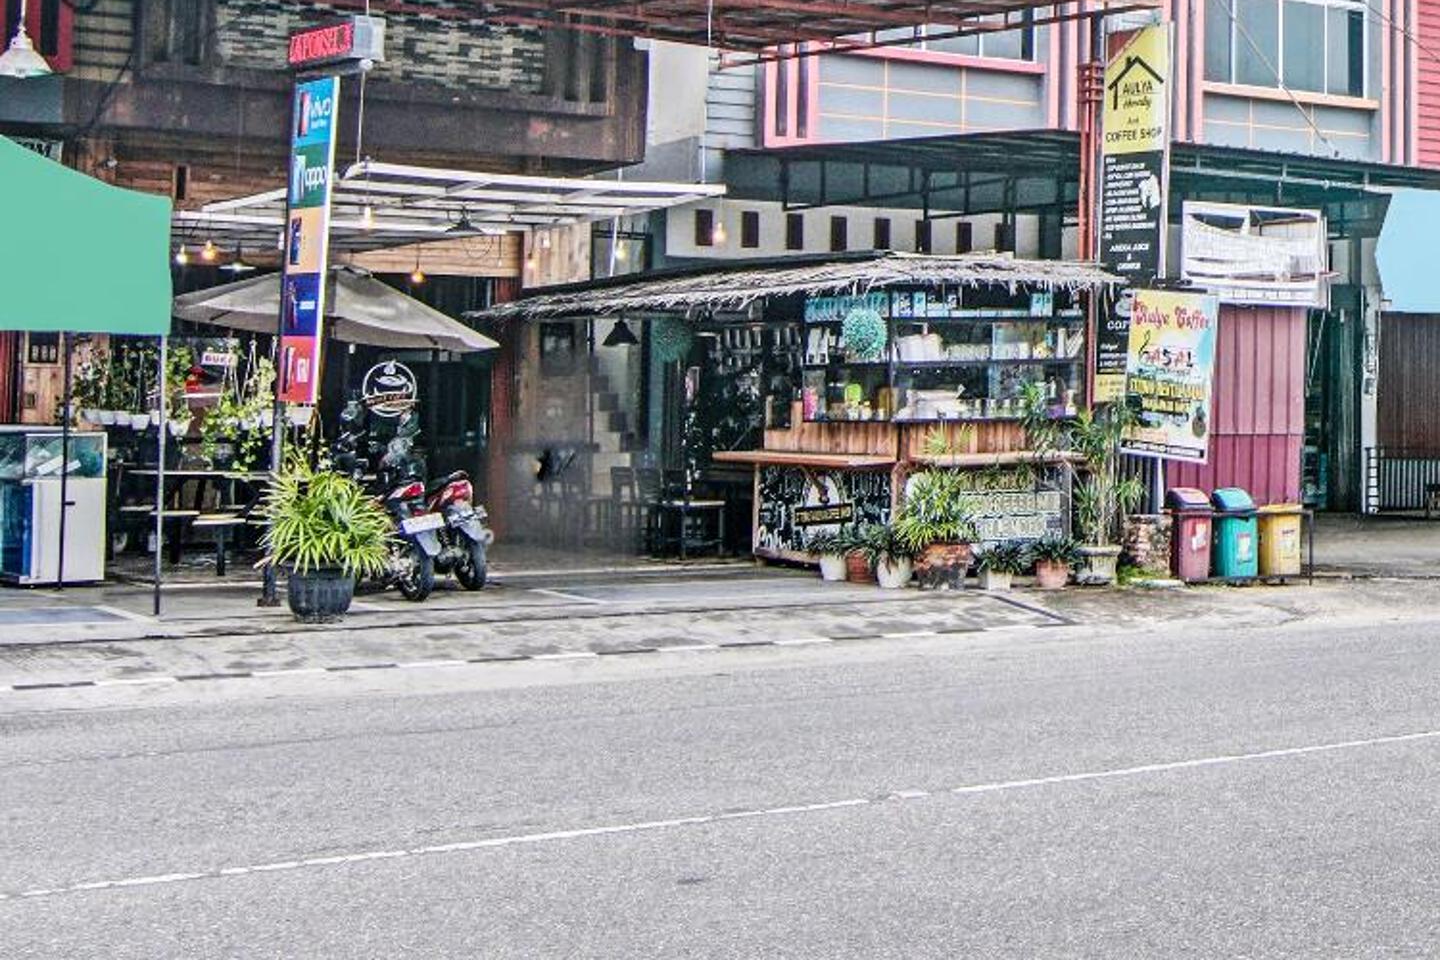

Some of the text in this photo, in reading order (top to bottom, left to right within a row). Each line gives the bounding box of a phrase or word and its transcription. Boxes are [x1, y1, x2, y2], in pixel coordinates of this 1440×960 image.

[1106, 126, 1162, 142] COFFEE SHOP
[305, 165, 328, 191] oppo
